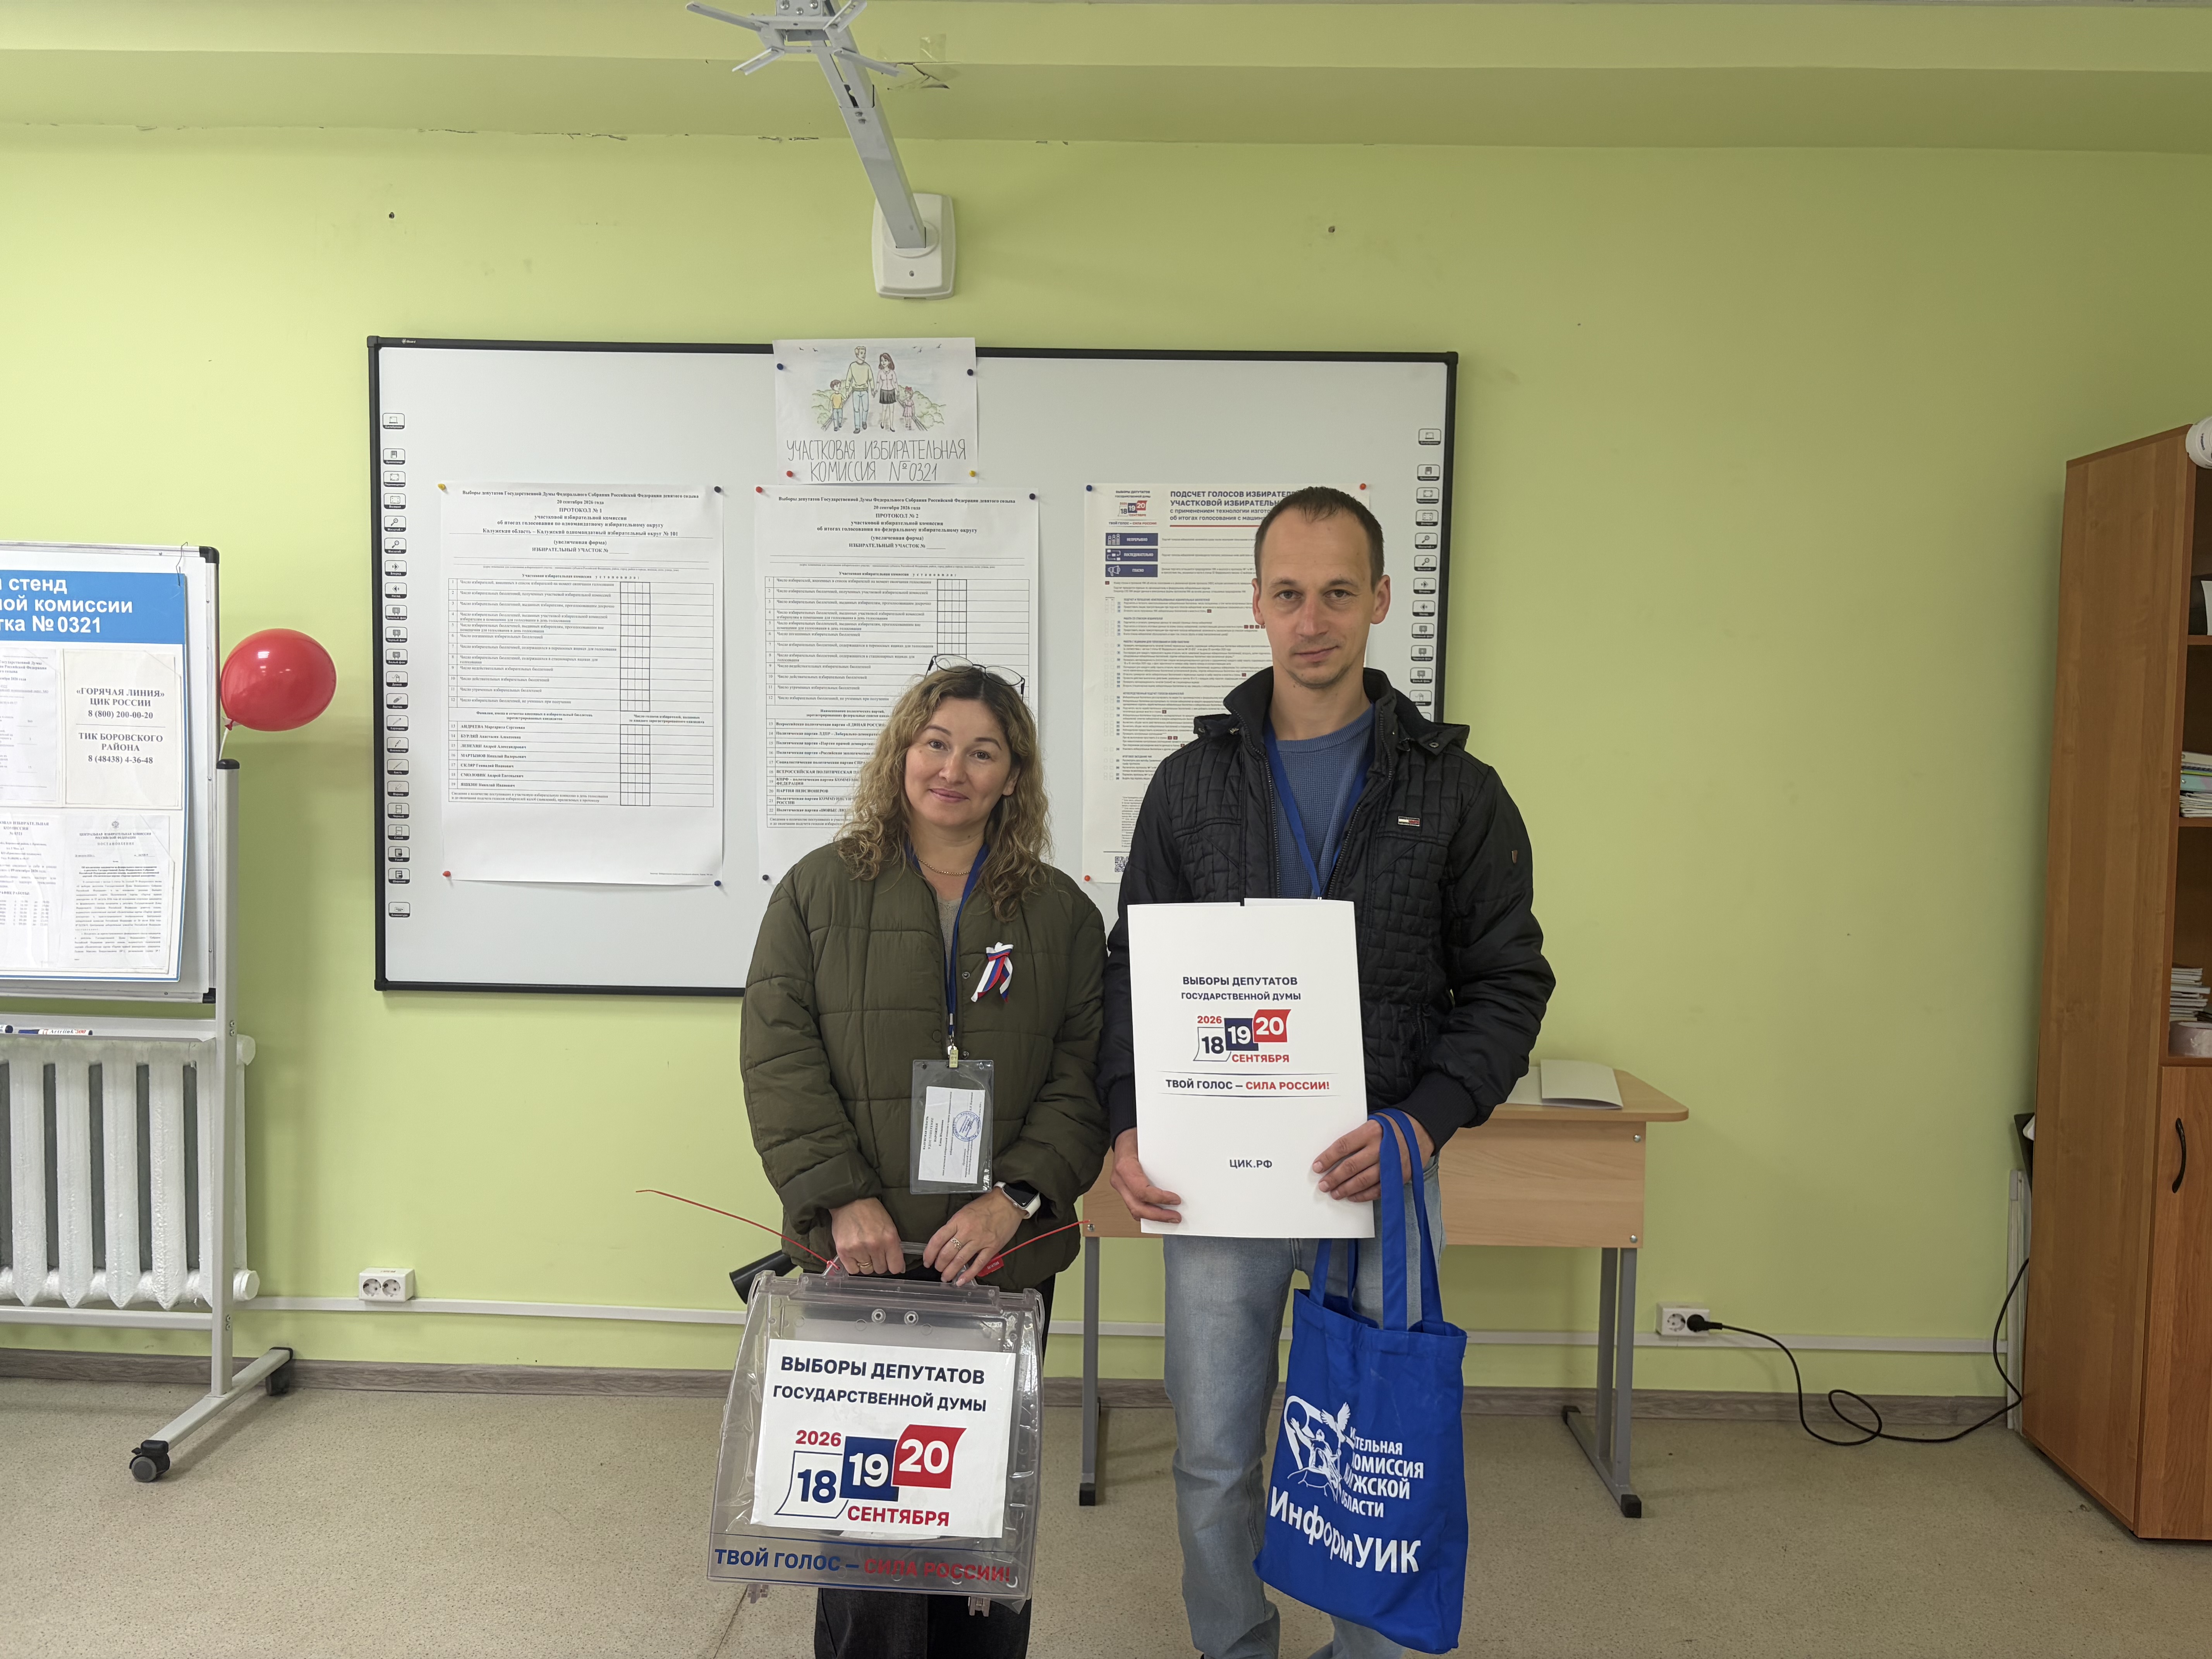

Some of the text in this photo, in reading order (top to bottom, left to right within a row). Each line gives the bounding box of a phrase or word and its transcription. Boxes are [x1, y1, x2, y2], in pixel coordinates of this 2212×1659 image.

[787, 439, 966, 461] УЧАСТКОВАЯ ИЗБИРАТЕЛЬНАЯ
[811, 461, 876, 482] КОМИССИЯ
[9, 579, 67, 594] стенд
[35, 599, 132, 613] комиссии
[100, 733, 163, 742] БОРОВСКОГО
[102, 743, 139, 751] РАЙОНА
[95, 756, 122, 764] (48438)
[1183, 977, 1297, 986] ВЫБОРЫ ДЕПУТАТОВ
[1181, 992, 1269, 1000] ГОСУДАРСТВЕННОЙ
[1202, 1017, 1284, 1054] 18 19 20
[1232, 1054, 1289, 1063] СЕНТЯБРЯ
[1166, 1079, 1194, 1089] ТВОЙ
[1197, 1081, 1233, 1089] ГОЛОС
[1246, 1082, 1276, 1090] СИЛА
[1279, 1082, 1329, 1090] РОССИИ!
[1230, 1159, 1272, 1169] ЦИК.РФ
[781, 1357, 985, 1384] ВЫБОРЫ ДЕПУТАТОВ
[773, 1385, 986, 1412] ГОСУДАРСТВЕННОЙ ДУМЫ
[795, 1430, 841, 1446] 2026
[797, 1439, 950, 1503] 18 19 20
[847, 1506, 949, 1527] СЕНТЯБРЯ
[1270, 1486, 1421, 1573] ИнформУИК
[715, 1547, 768, 1568] ТВОЙ
[774, 1553, 840, 1571] ГОЛОС
[864, 1559, 917, 1577] СИЛА
[924, 1563, 1010, 1582] РОССИИ!
